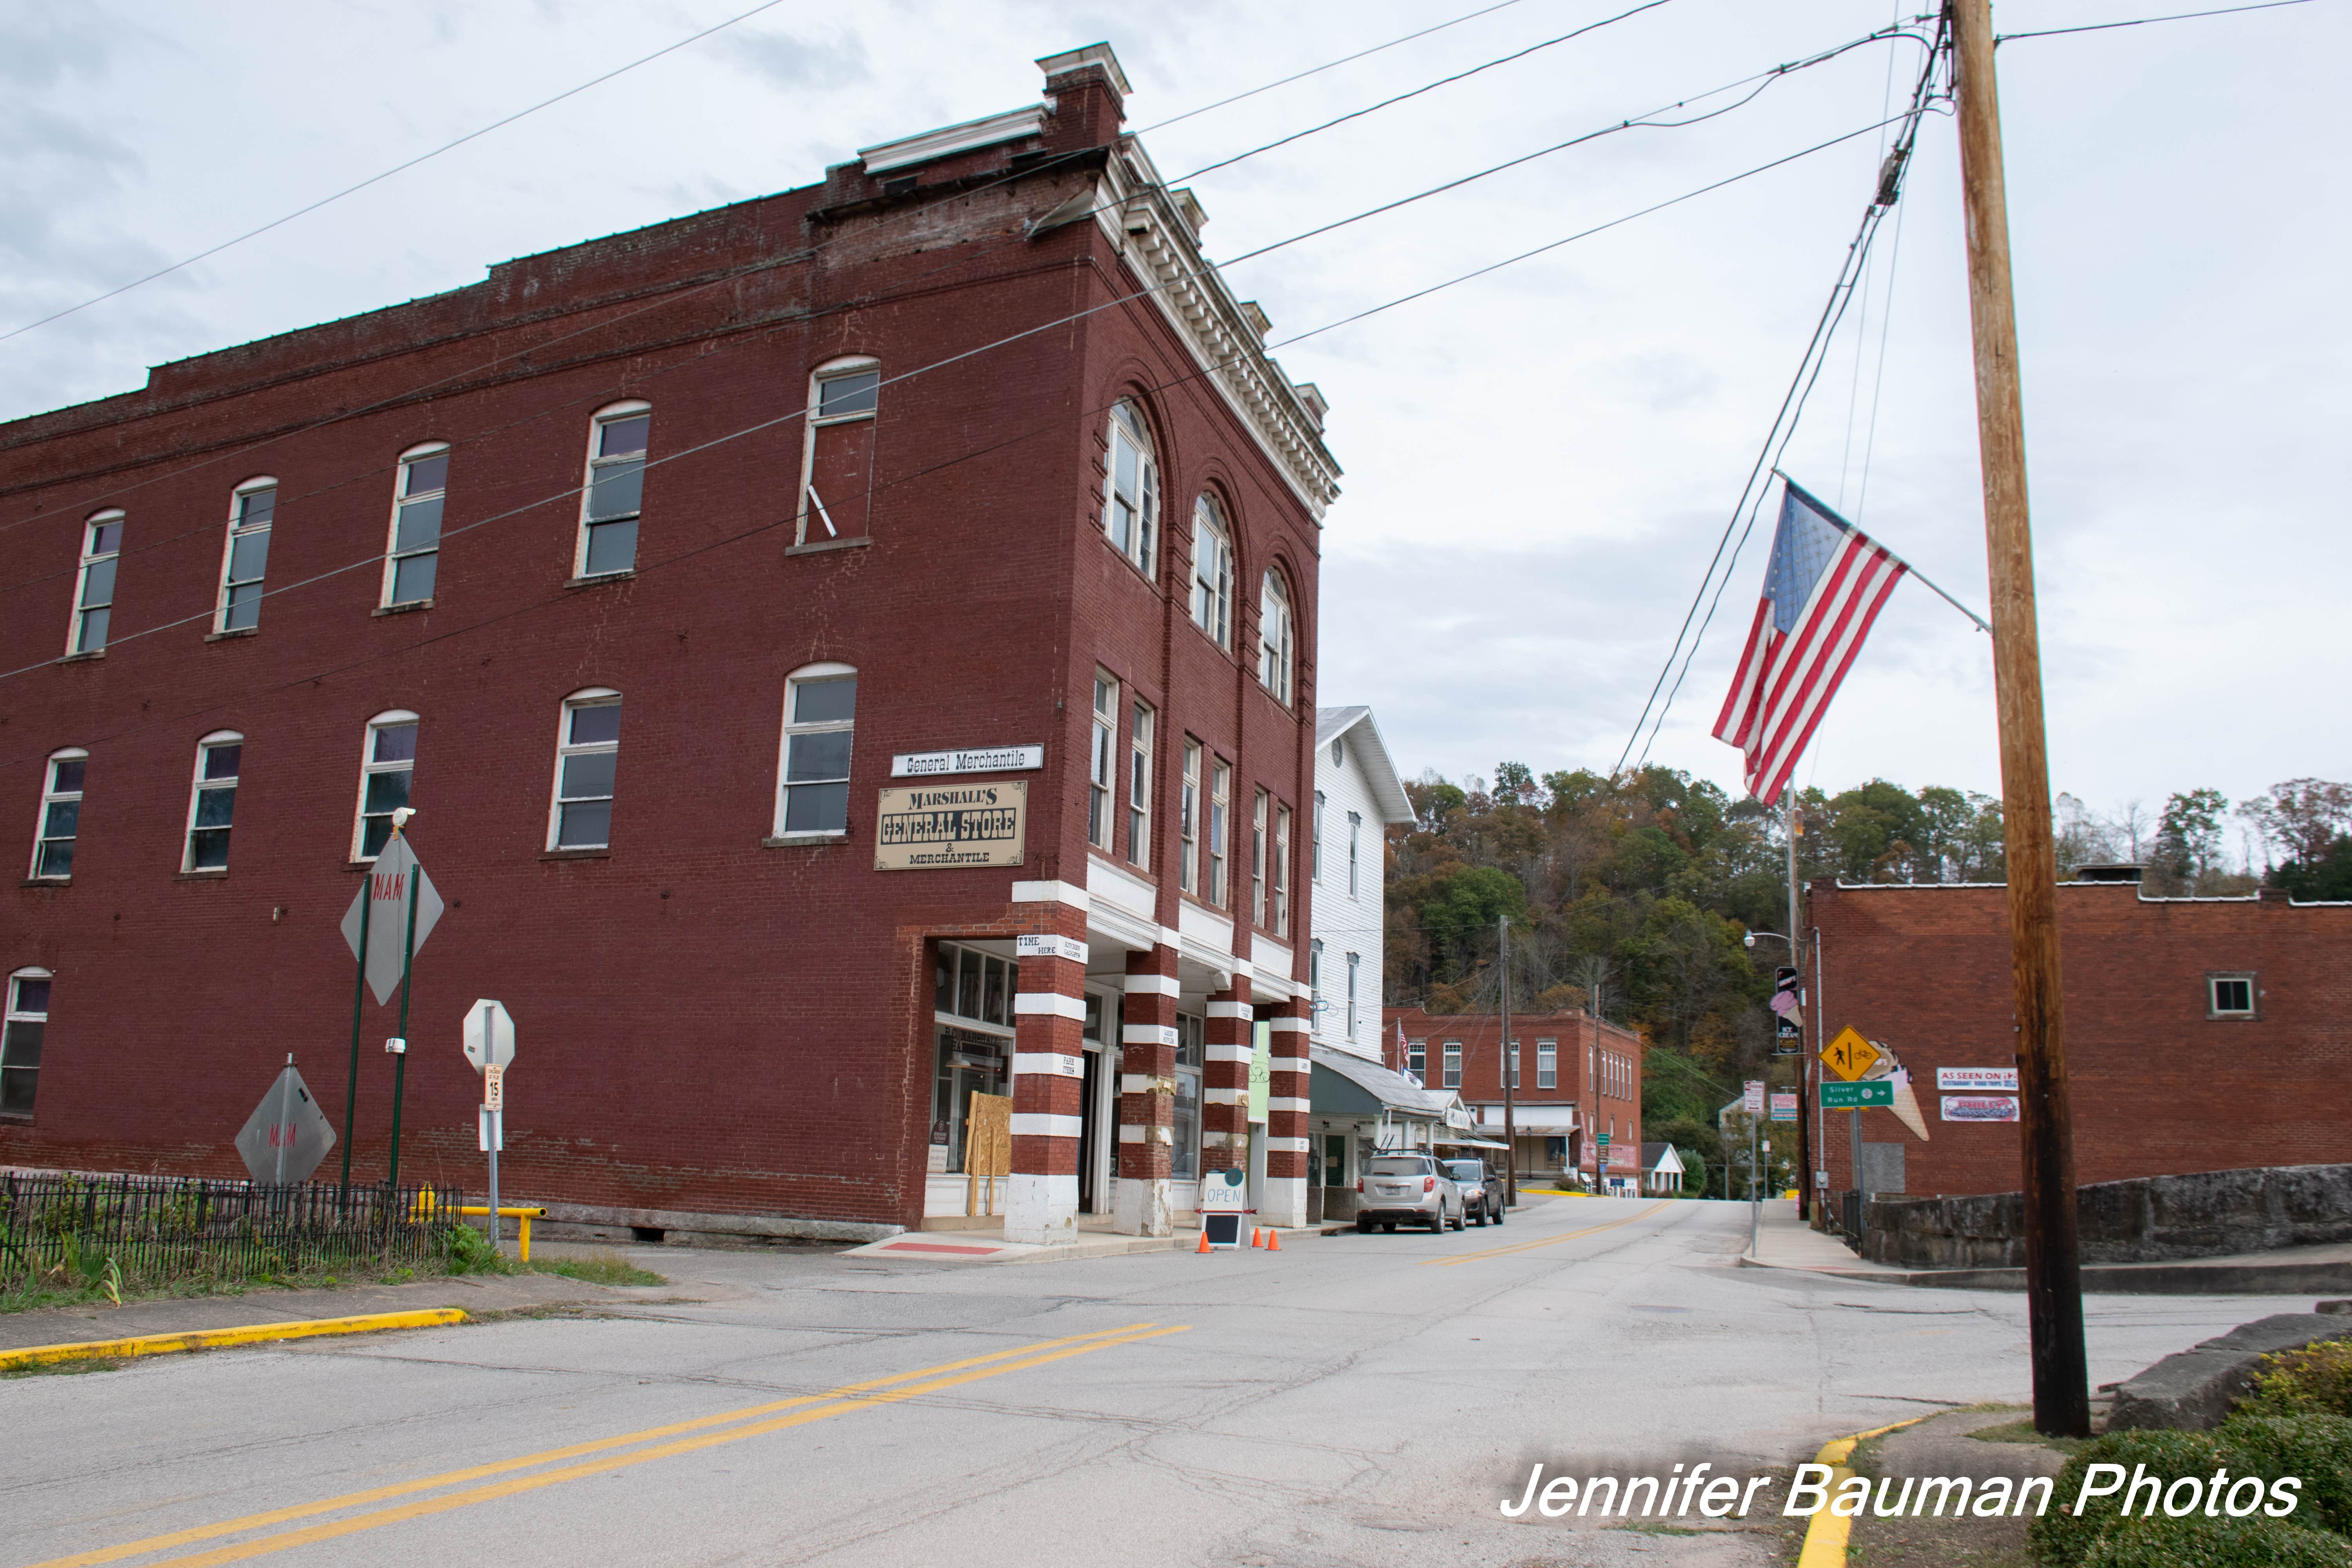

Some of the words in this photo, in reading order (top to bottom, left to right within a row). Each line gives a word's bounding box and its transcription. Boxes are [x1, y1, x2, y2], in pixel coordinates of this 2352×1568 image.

[907, 757, 949, 773] General
[955, 750, 1025, 770] Merchantile
[908, 788, 997, 810] MARSHALL'S
[882, 811, 956, 843] GENERAL
[961, 809, 1014, 840] STORE
[945, 843, 954, 853] &
[909, 852, 990, 864] MERCHANTILE
[373, 873, 405, 901] MAM
[1018, 936, 1039, 946] TIME
[1065, 942, 1080, 951] KITCHEN
[1064, 949, 1080, 958] GADGETS
[1063, 1056, 1074, 1065] FARM
[1063, 1066, 1074, 1074] ITEMS
[490, 1082, 499, 1096] 15
[1208, 1189, 1241, 1202] OPEN
